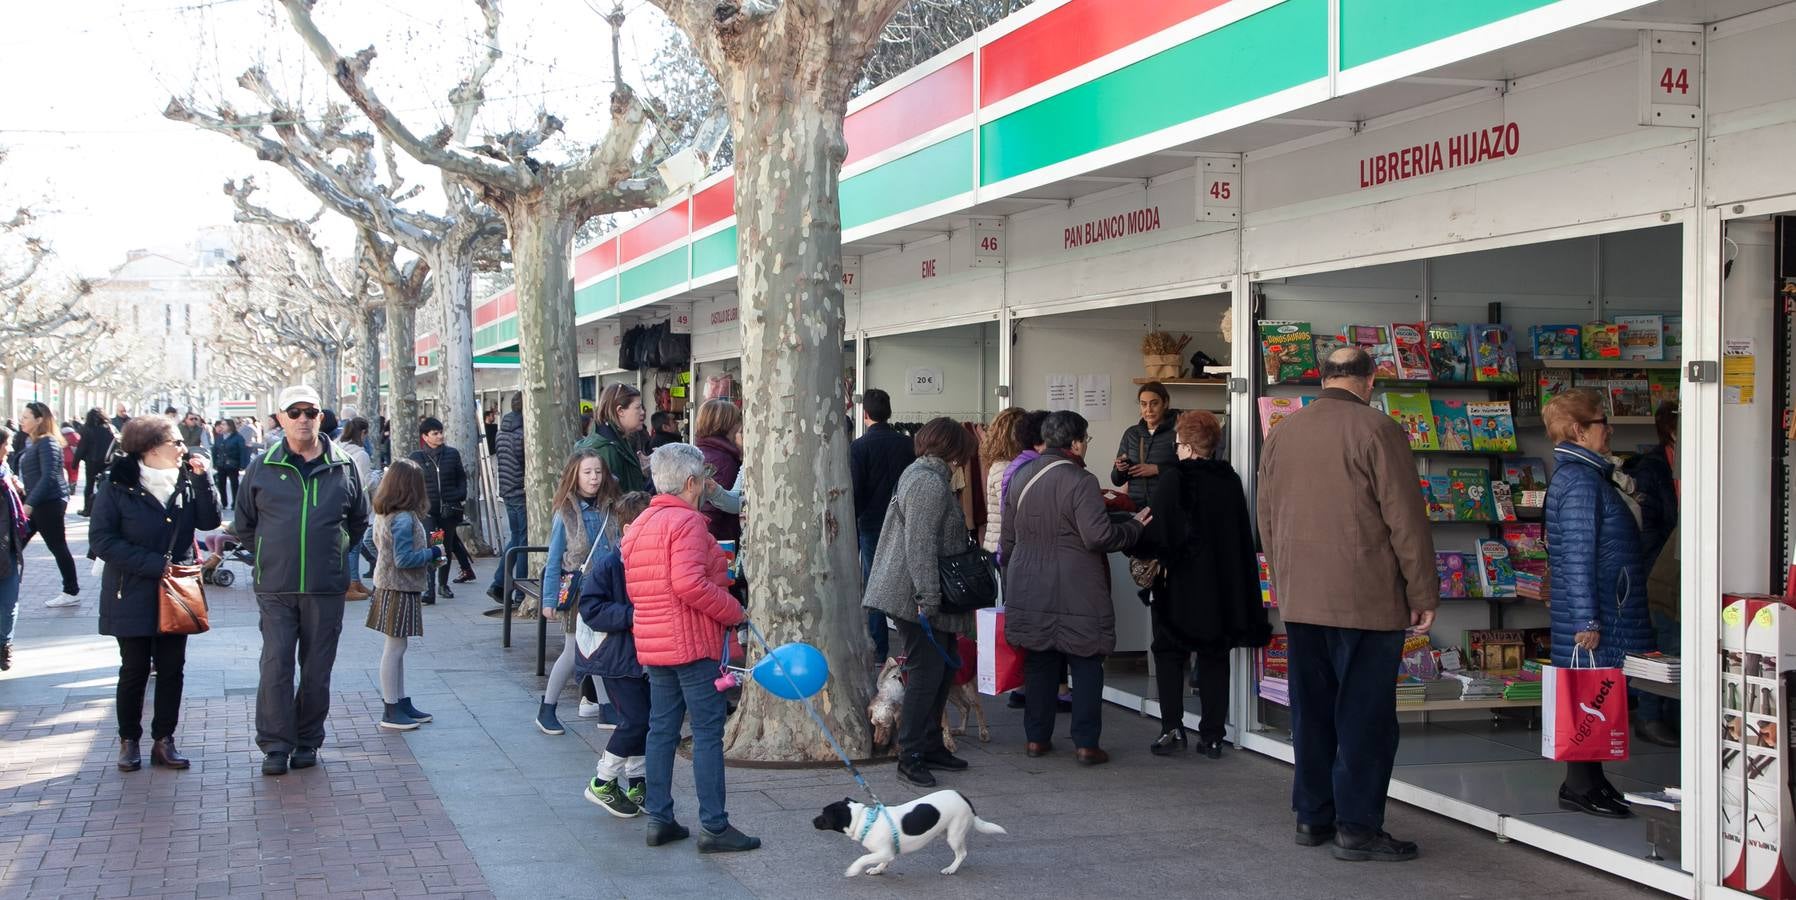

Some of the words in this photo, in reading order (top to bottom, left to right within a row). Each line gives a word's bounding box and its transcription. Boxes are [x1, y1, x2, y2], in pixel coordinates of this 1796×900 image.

[1660, 67, 1689, 95] 44
[1360, 141, 1444, 190] LIBRERIA
[1448, 122, 1520, 169] HIJAZO
[1210, 181, 1231, 200] 45
[1064, 226, 1083, 250] PAN
[1084, 215, 1125, 244] BLANCO
[1127, 206, 1160, 235] MODA
[981, 237, 998, 251] 46
[921, 259, 936, 279] EME
[842, 272, 854, 285] 47
[677, 315, 688, 324] 49
[917, 376, 926, 384] 20
[927, 376, 933, 384] €
[1471, 631, 1523, 642] POMPEYA
